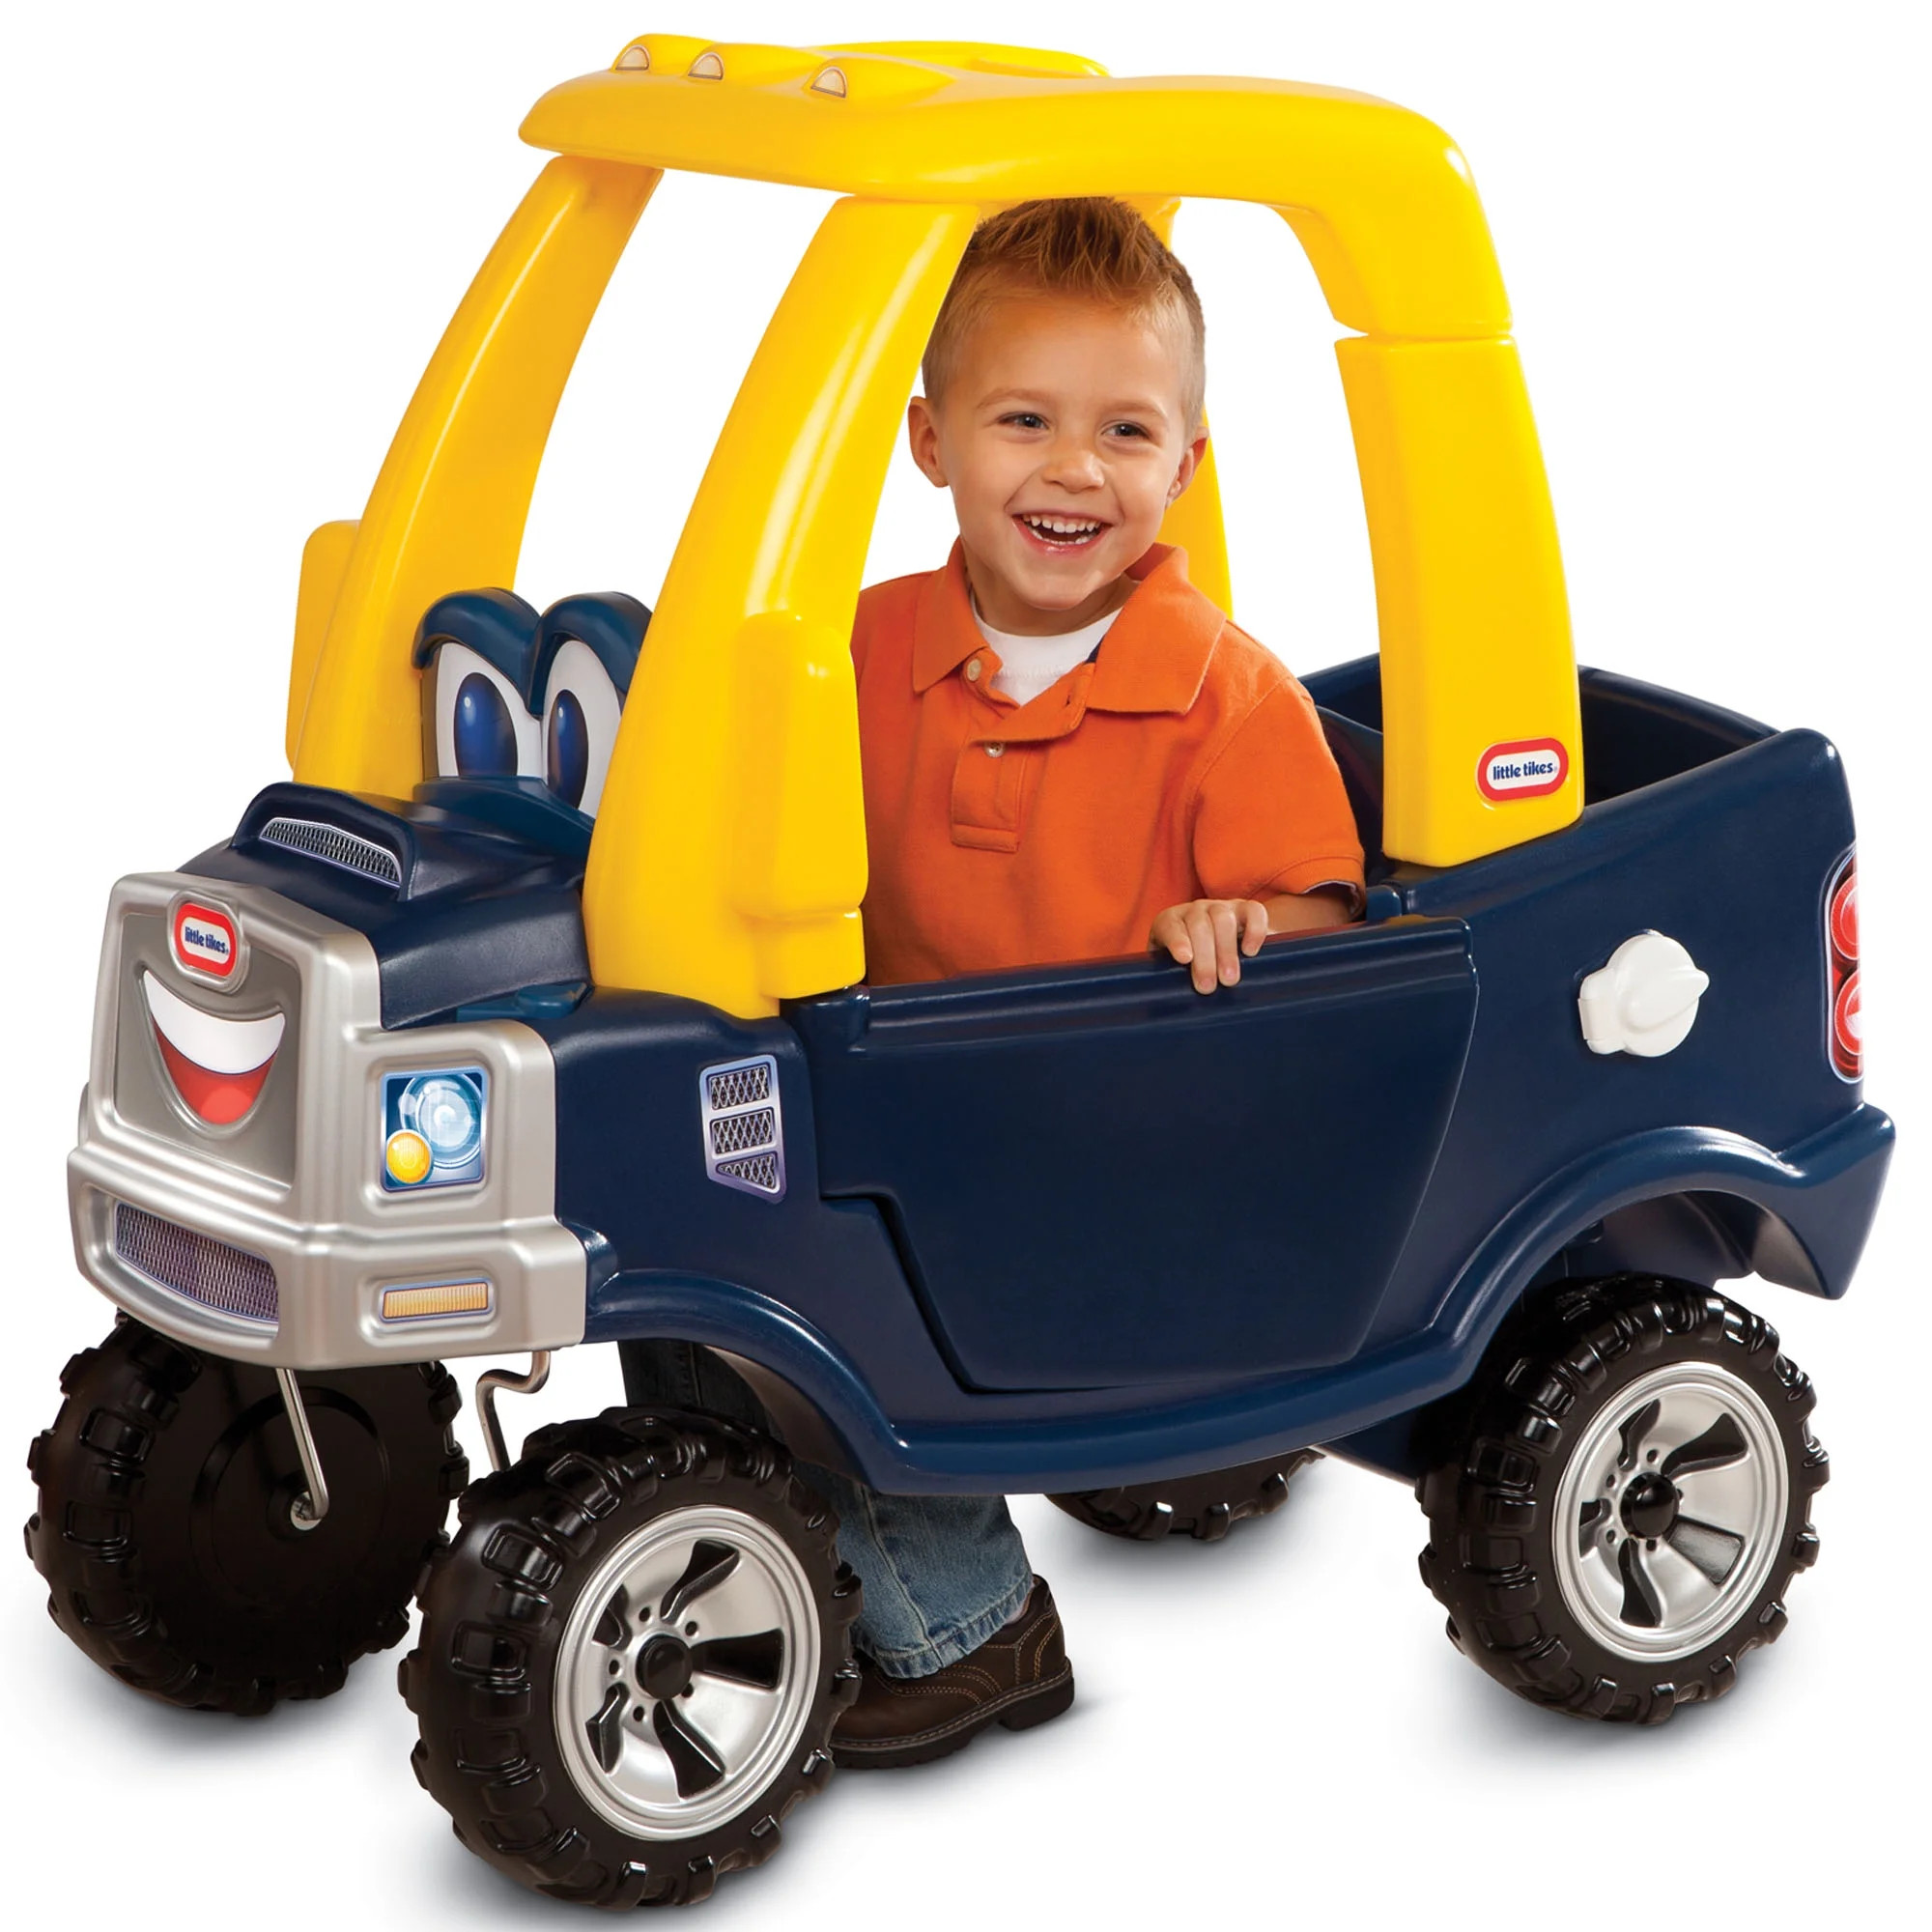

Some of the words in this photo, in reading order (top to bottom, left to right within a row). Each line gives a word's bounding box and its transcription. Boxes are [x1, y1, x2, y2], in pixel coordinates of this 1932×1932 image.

[1493, 764, 1521, 781] little
[1523, 760, 1553, 777] tikes
[185, 925, 204, 947] little
[206, 933, 225, 954] tikes
